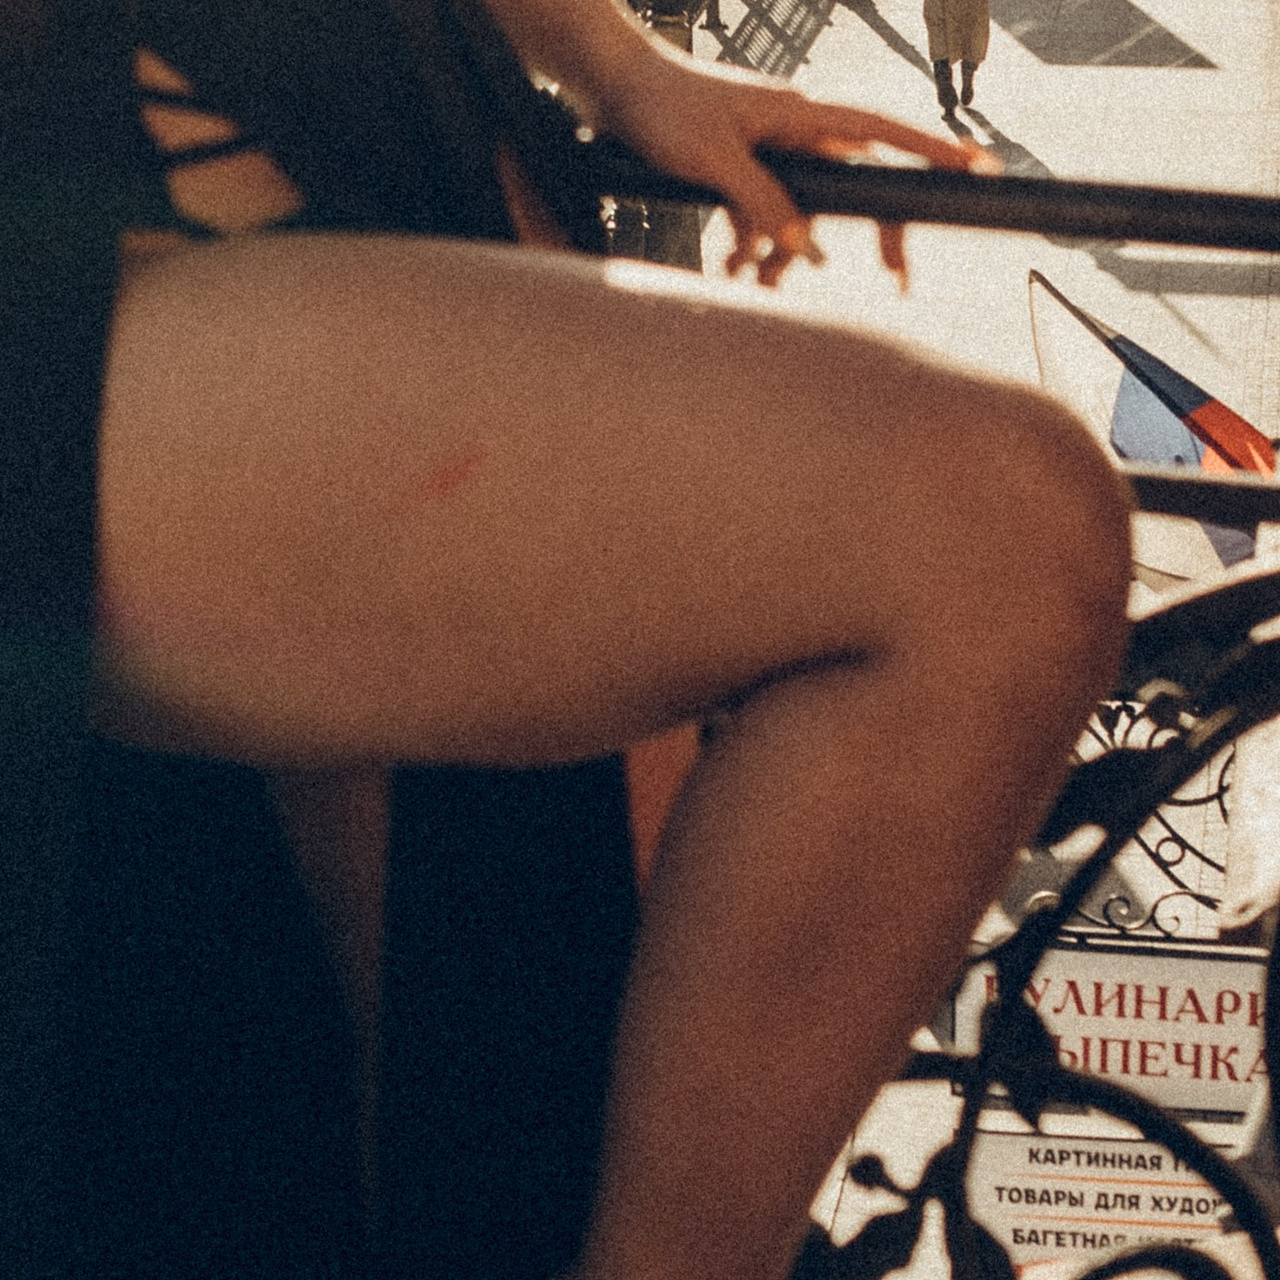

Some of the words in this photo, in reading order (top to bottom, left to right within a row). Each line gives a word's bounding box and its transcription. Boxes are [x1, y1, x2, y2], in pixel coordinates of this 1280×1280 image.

[1028, 1147, 1163, 1171] КАРТИННАЯ
[995, 1186, 1085, 1208] ТОВАРЫ
[1094, 1192, 1140, 1211] ДЛЯ
